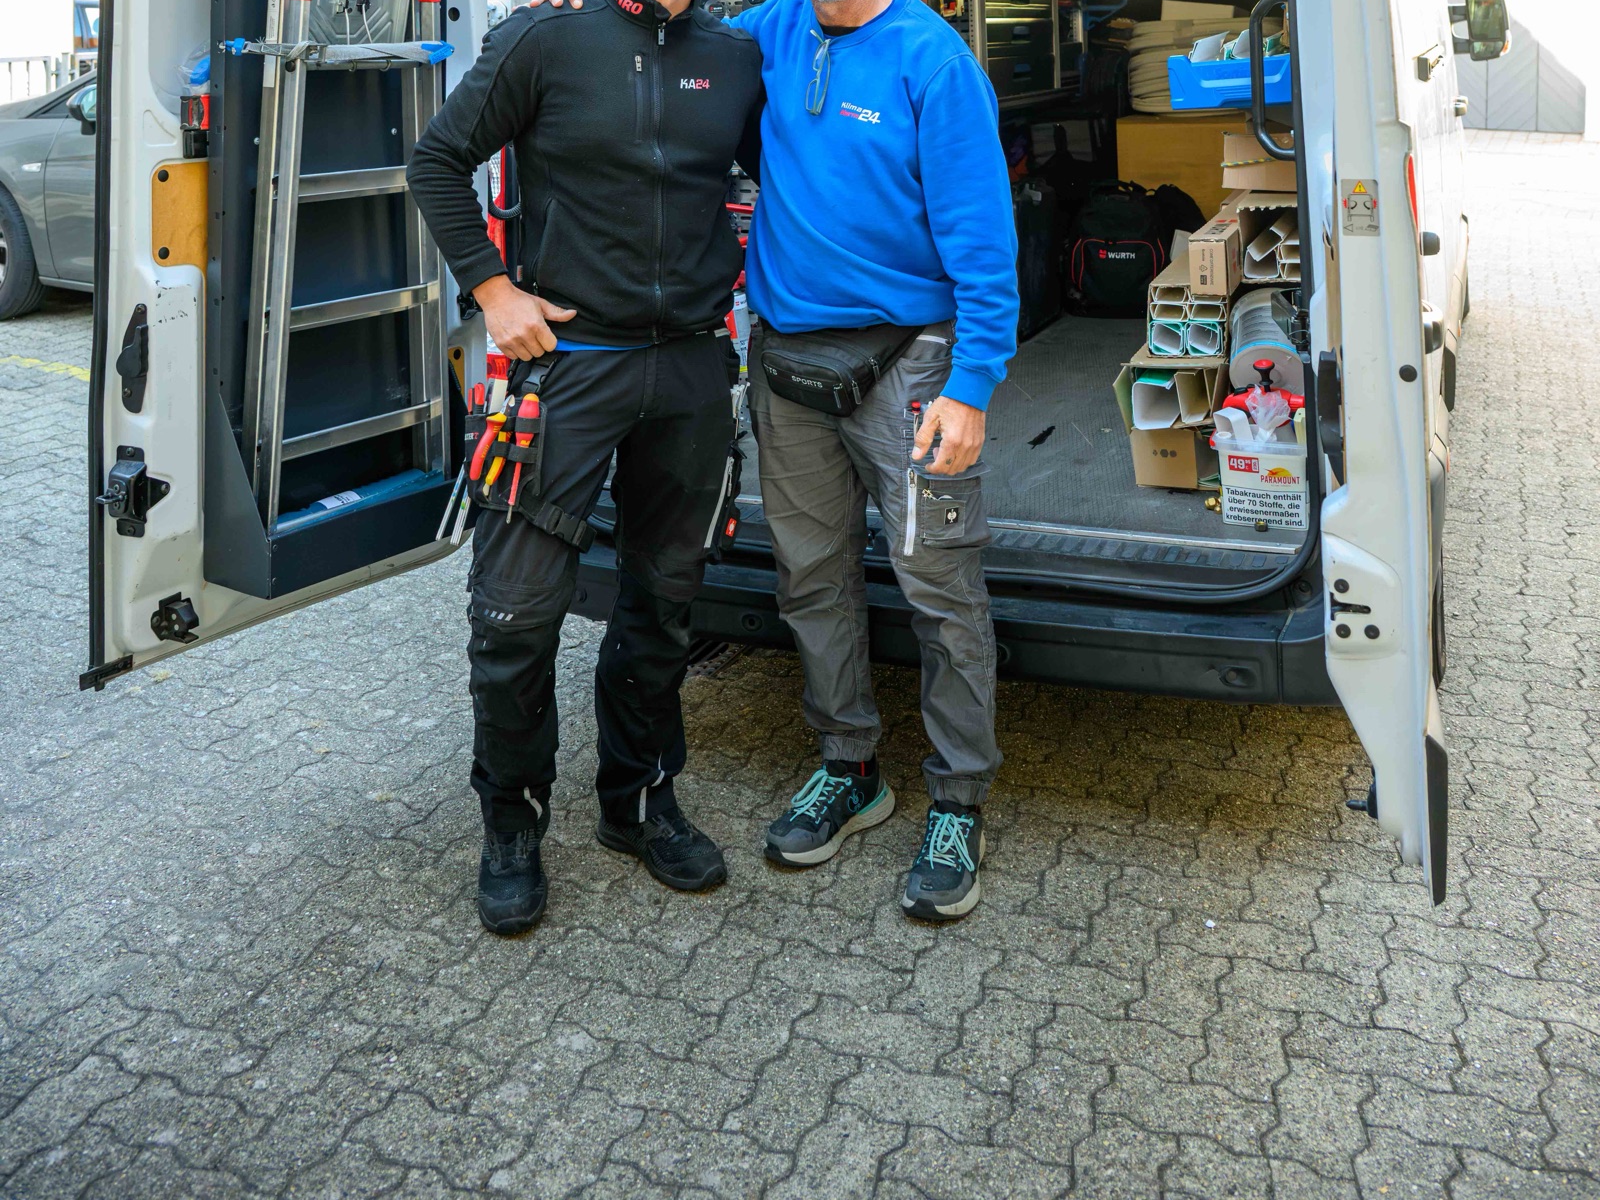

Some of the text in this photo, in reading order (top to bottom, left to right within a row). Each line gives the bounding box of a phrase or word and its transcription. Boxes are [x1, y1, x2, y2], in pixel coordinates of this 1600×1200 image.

[680, 78, 710, 90] KA24
[858, 108, 881, 125] 24
[1107, 251, 1136, 259] WÜRTH
[791, 375, 823, 388] SPORTS
[1260, 474, 1300, 485] PARAMOUNT
[1226, 487, 1302, 501] Tabakrauch enthält
[1228, 497, 1301, 510] über 70 Stoffe, die
[1229, 506, 1300, 518] erwiesenermaßen
[1284, 519, 1305, 527] sind.
